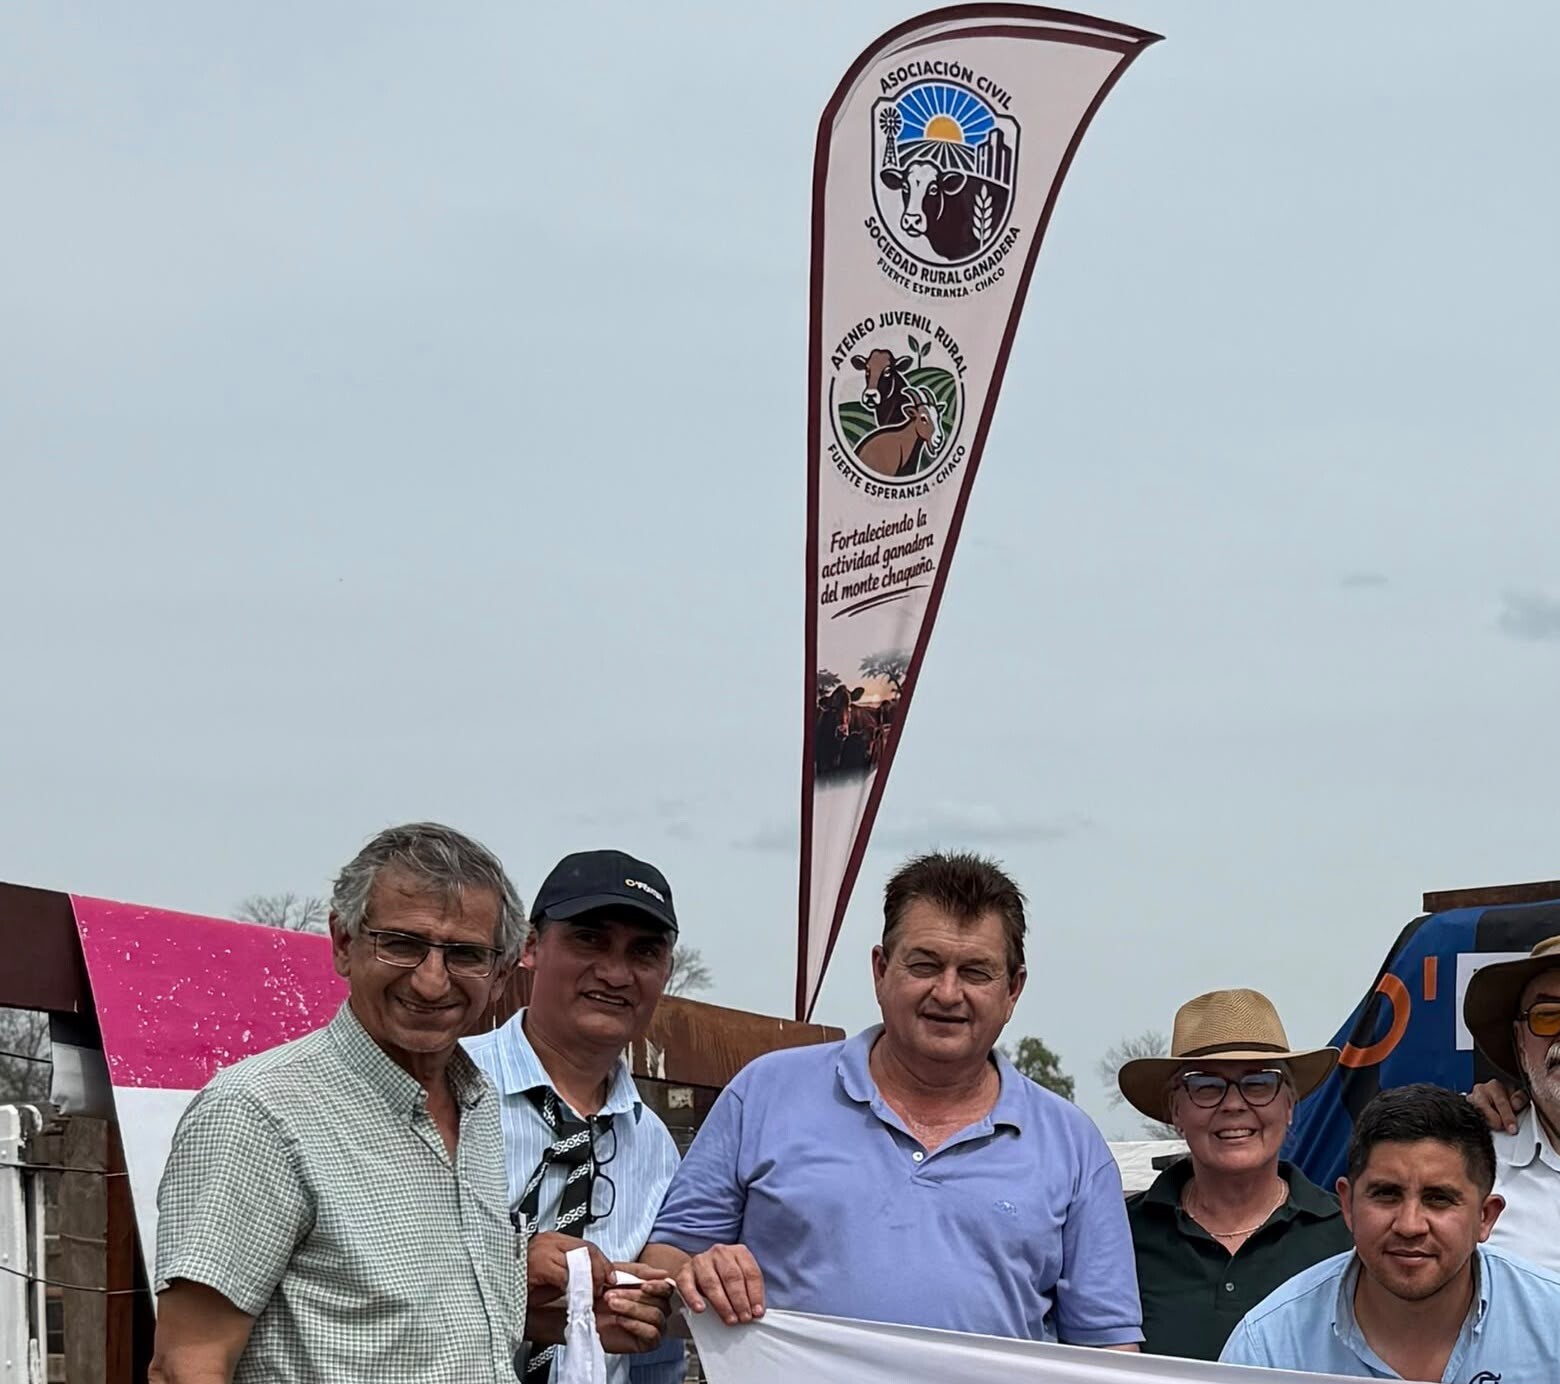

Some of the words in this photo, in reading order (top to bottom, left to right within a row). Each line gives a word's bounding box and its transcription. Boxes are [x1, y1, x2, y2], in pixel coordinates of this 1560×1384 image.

[879, 61, 973, 94] ASOCIACIÓN
[977, 76, 1012, 110] CIVIL
[864, 216, 918, 277] SOCIEDAD
[920, 265, 962, 285] RURAL
[962, 226, 1021, 282] GANADERA
[876, 257, 911, 290] FUERTE
[912, 281, 968, 299] ESPERANZA
[974, 266, 1006, 293] CHACO
[831, 317, 876, 371] ATENEO
[878, 311, 932, 335] JUVENIL
[933, 326, 969, 379] RURAL
[827, 443, 863, 489] FUERTE
[864, 481, 930, 500] ESPERANZA
[935, 444, 966, 485] CHACO
[830, 515, 914, 554] Fortaleciendo
[916, 507, 928, 527] la
[820, 579, 840, 606] del
[840, 570, 880, 600] monte
[881, 556, 937, 590] chaqueño.
[821, 544, 881, 580] actividad
[882, 533, 935, 570] ganadera
